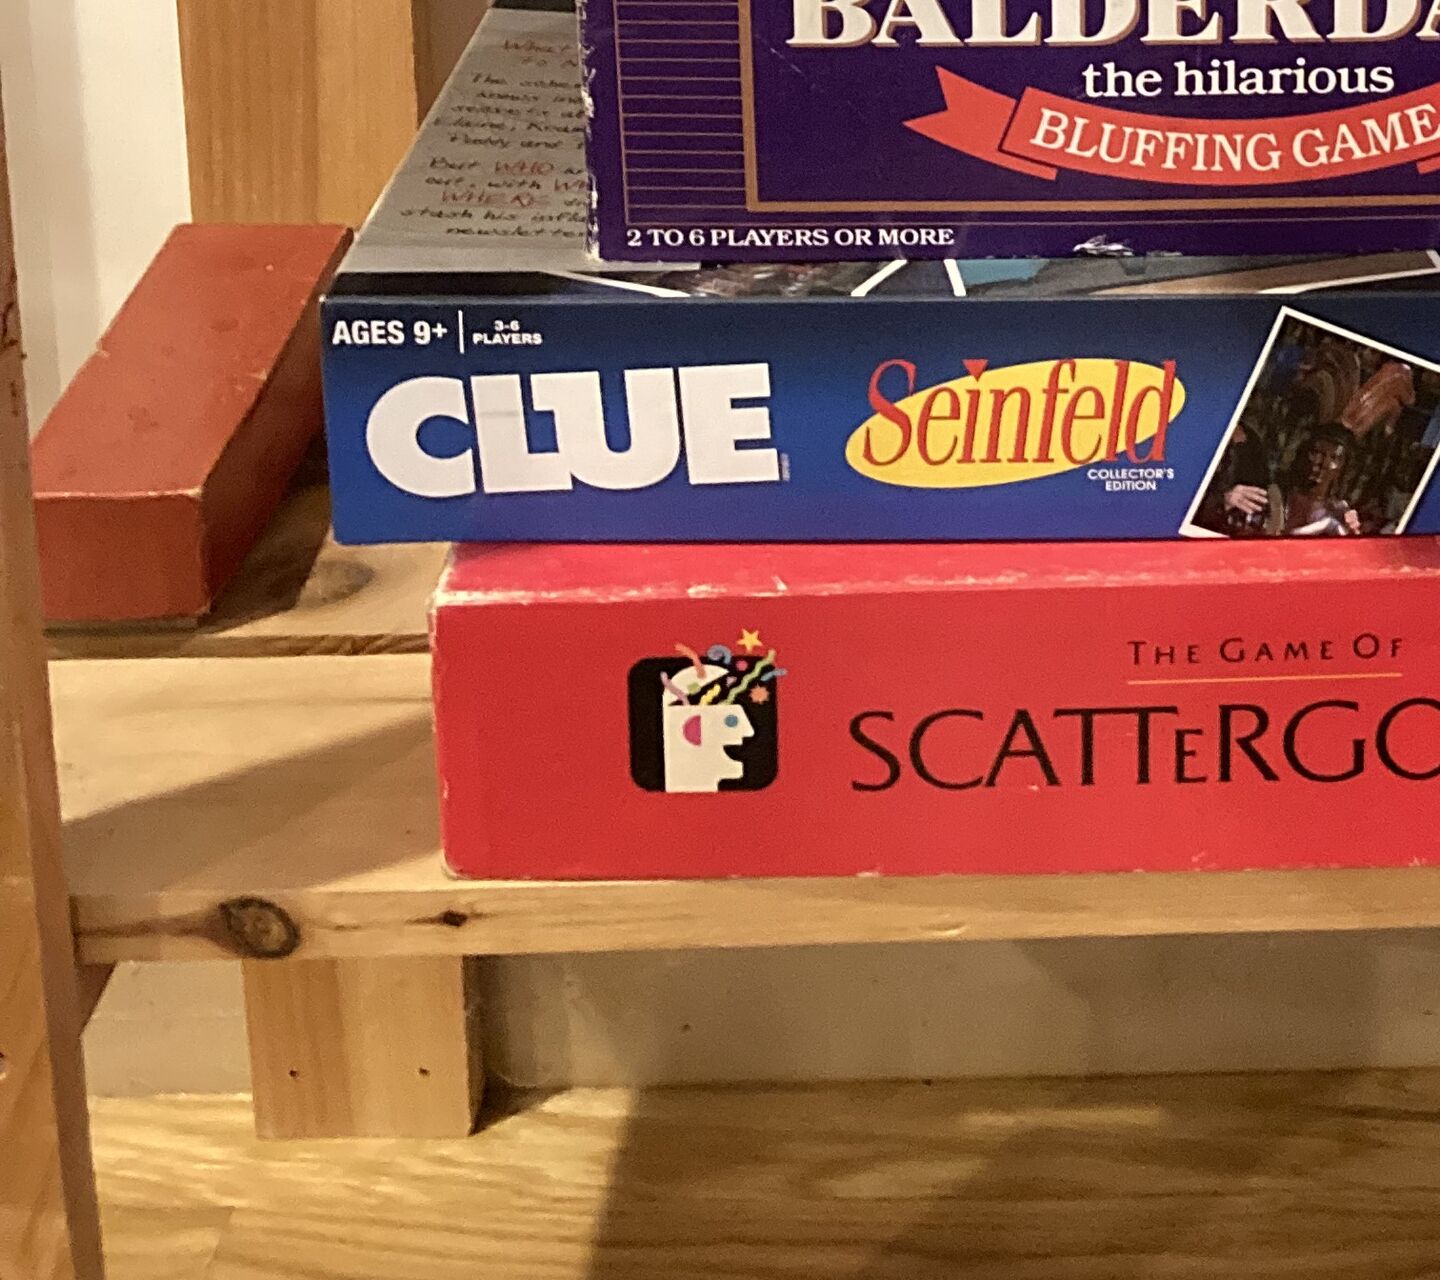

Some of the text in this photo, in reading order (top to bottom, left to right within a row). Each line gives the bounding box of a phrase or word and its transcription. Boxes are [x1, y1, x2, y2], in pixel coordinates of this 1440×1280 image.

[1082, 56, 1396, 99] the hilarious
[1029, 107, 1284, 172] BLUFFING
[627, 228, 954, 247] 2 TO 6 PLAYERS OR MORE
[332, 320, 448, 345] AGES 9+
[493, 320, 520, 332] 3-6
[472, 333, 543, 345] PLAYERS
[862, 359, 1177, 467] Seinfeld
[366, 362, 780, 498] CLUE
[1087, 468, 1175, 480] COLLECTOR'S
[1105, 480, 1157, 492] EDITION
[1128, 632, 1403, 667] THE GAME OF
